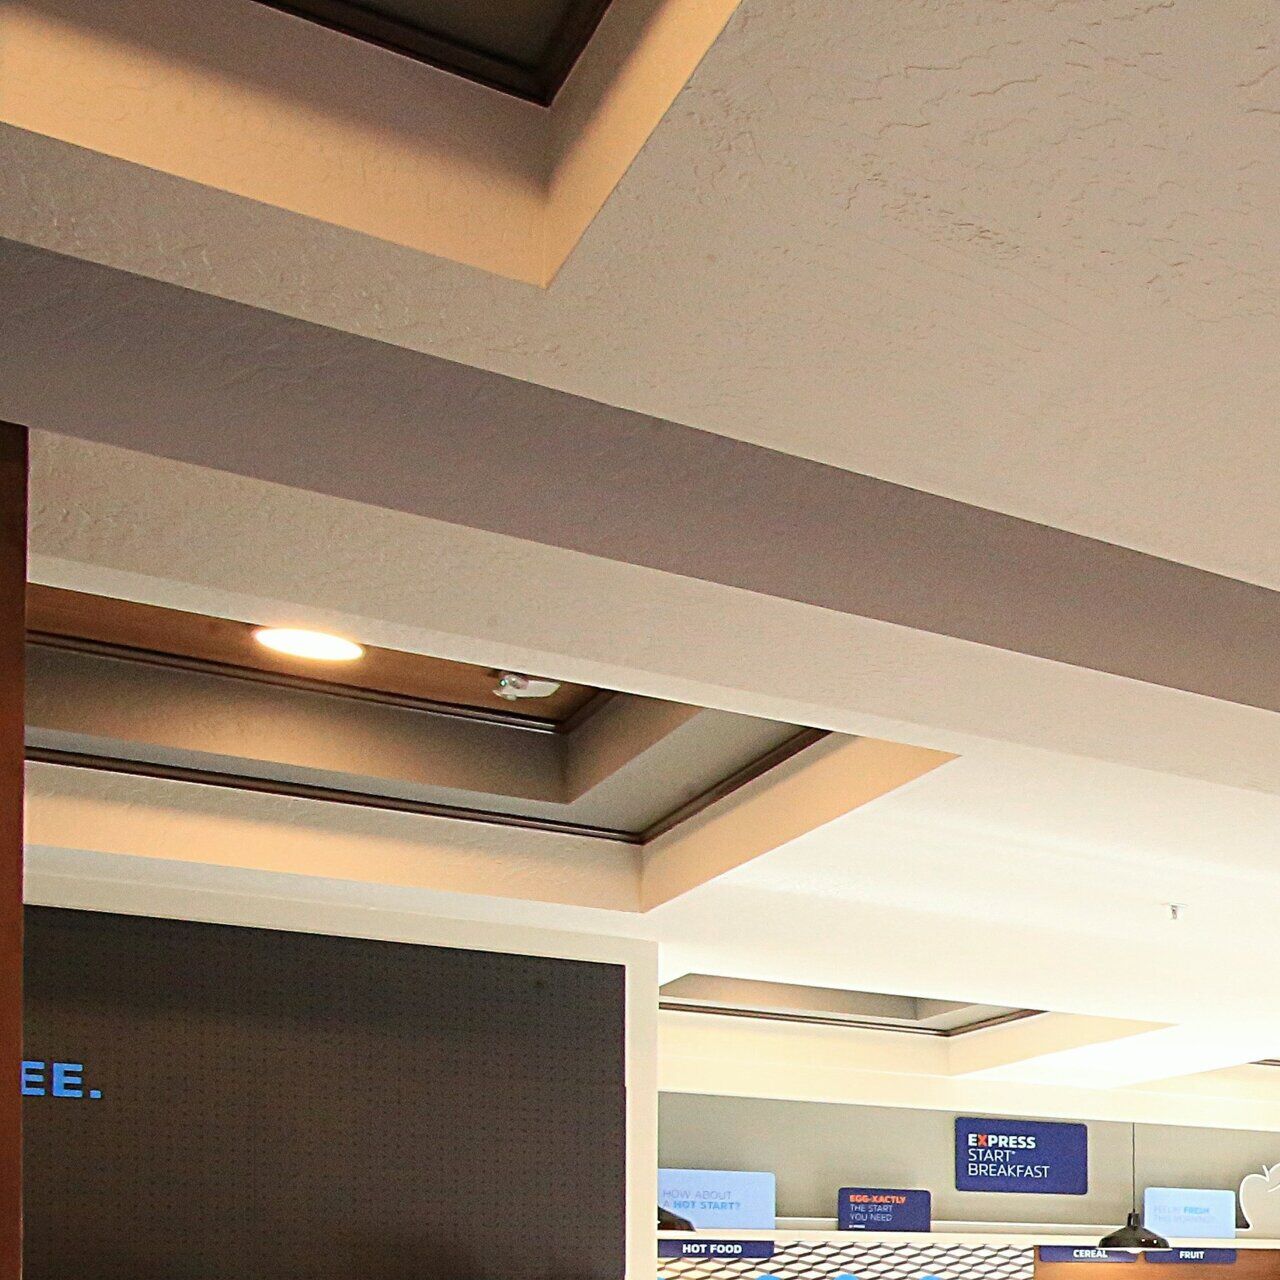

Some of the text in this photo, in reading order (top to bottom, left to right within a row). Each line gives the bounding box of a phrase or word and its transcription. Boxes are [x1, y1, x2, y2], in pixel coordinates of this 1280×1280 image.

[967, 1133, 1036, 1149] EXPRESS
[968, 1163, 1050, 1178] BREAKFAST
[662, 1189, 732, 1200] HOW ABOUT
[849, 1194, 906, 1204] EGG-XACTLY
[673, 1201, 696, 1209] HOT
[850, 1204, 893, 1213] THE START
[850, 1213, 893, 1222] YOU NEED
[682, 1243, 742, 1254] HOT FOOD
[1072, 1249, 1108, 1259] CEREAL
[1179, 1251, 1205, 1259] FRUIT
